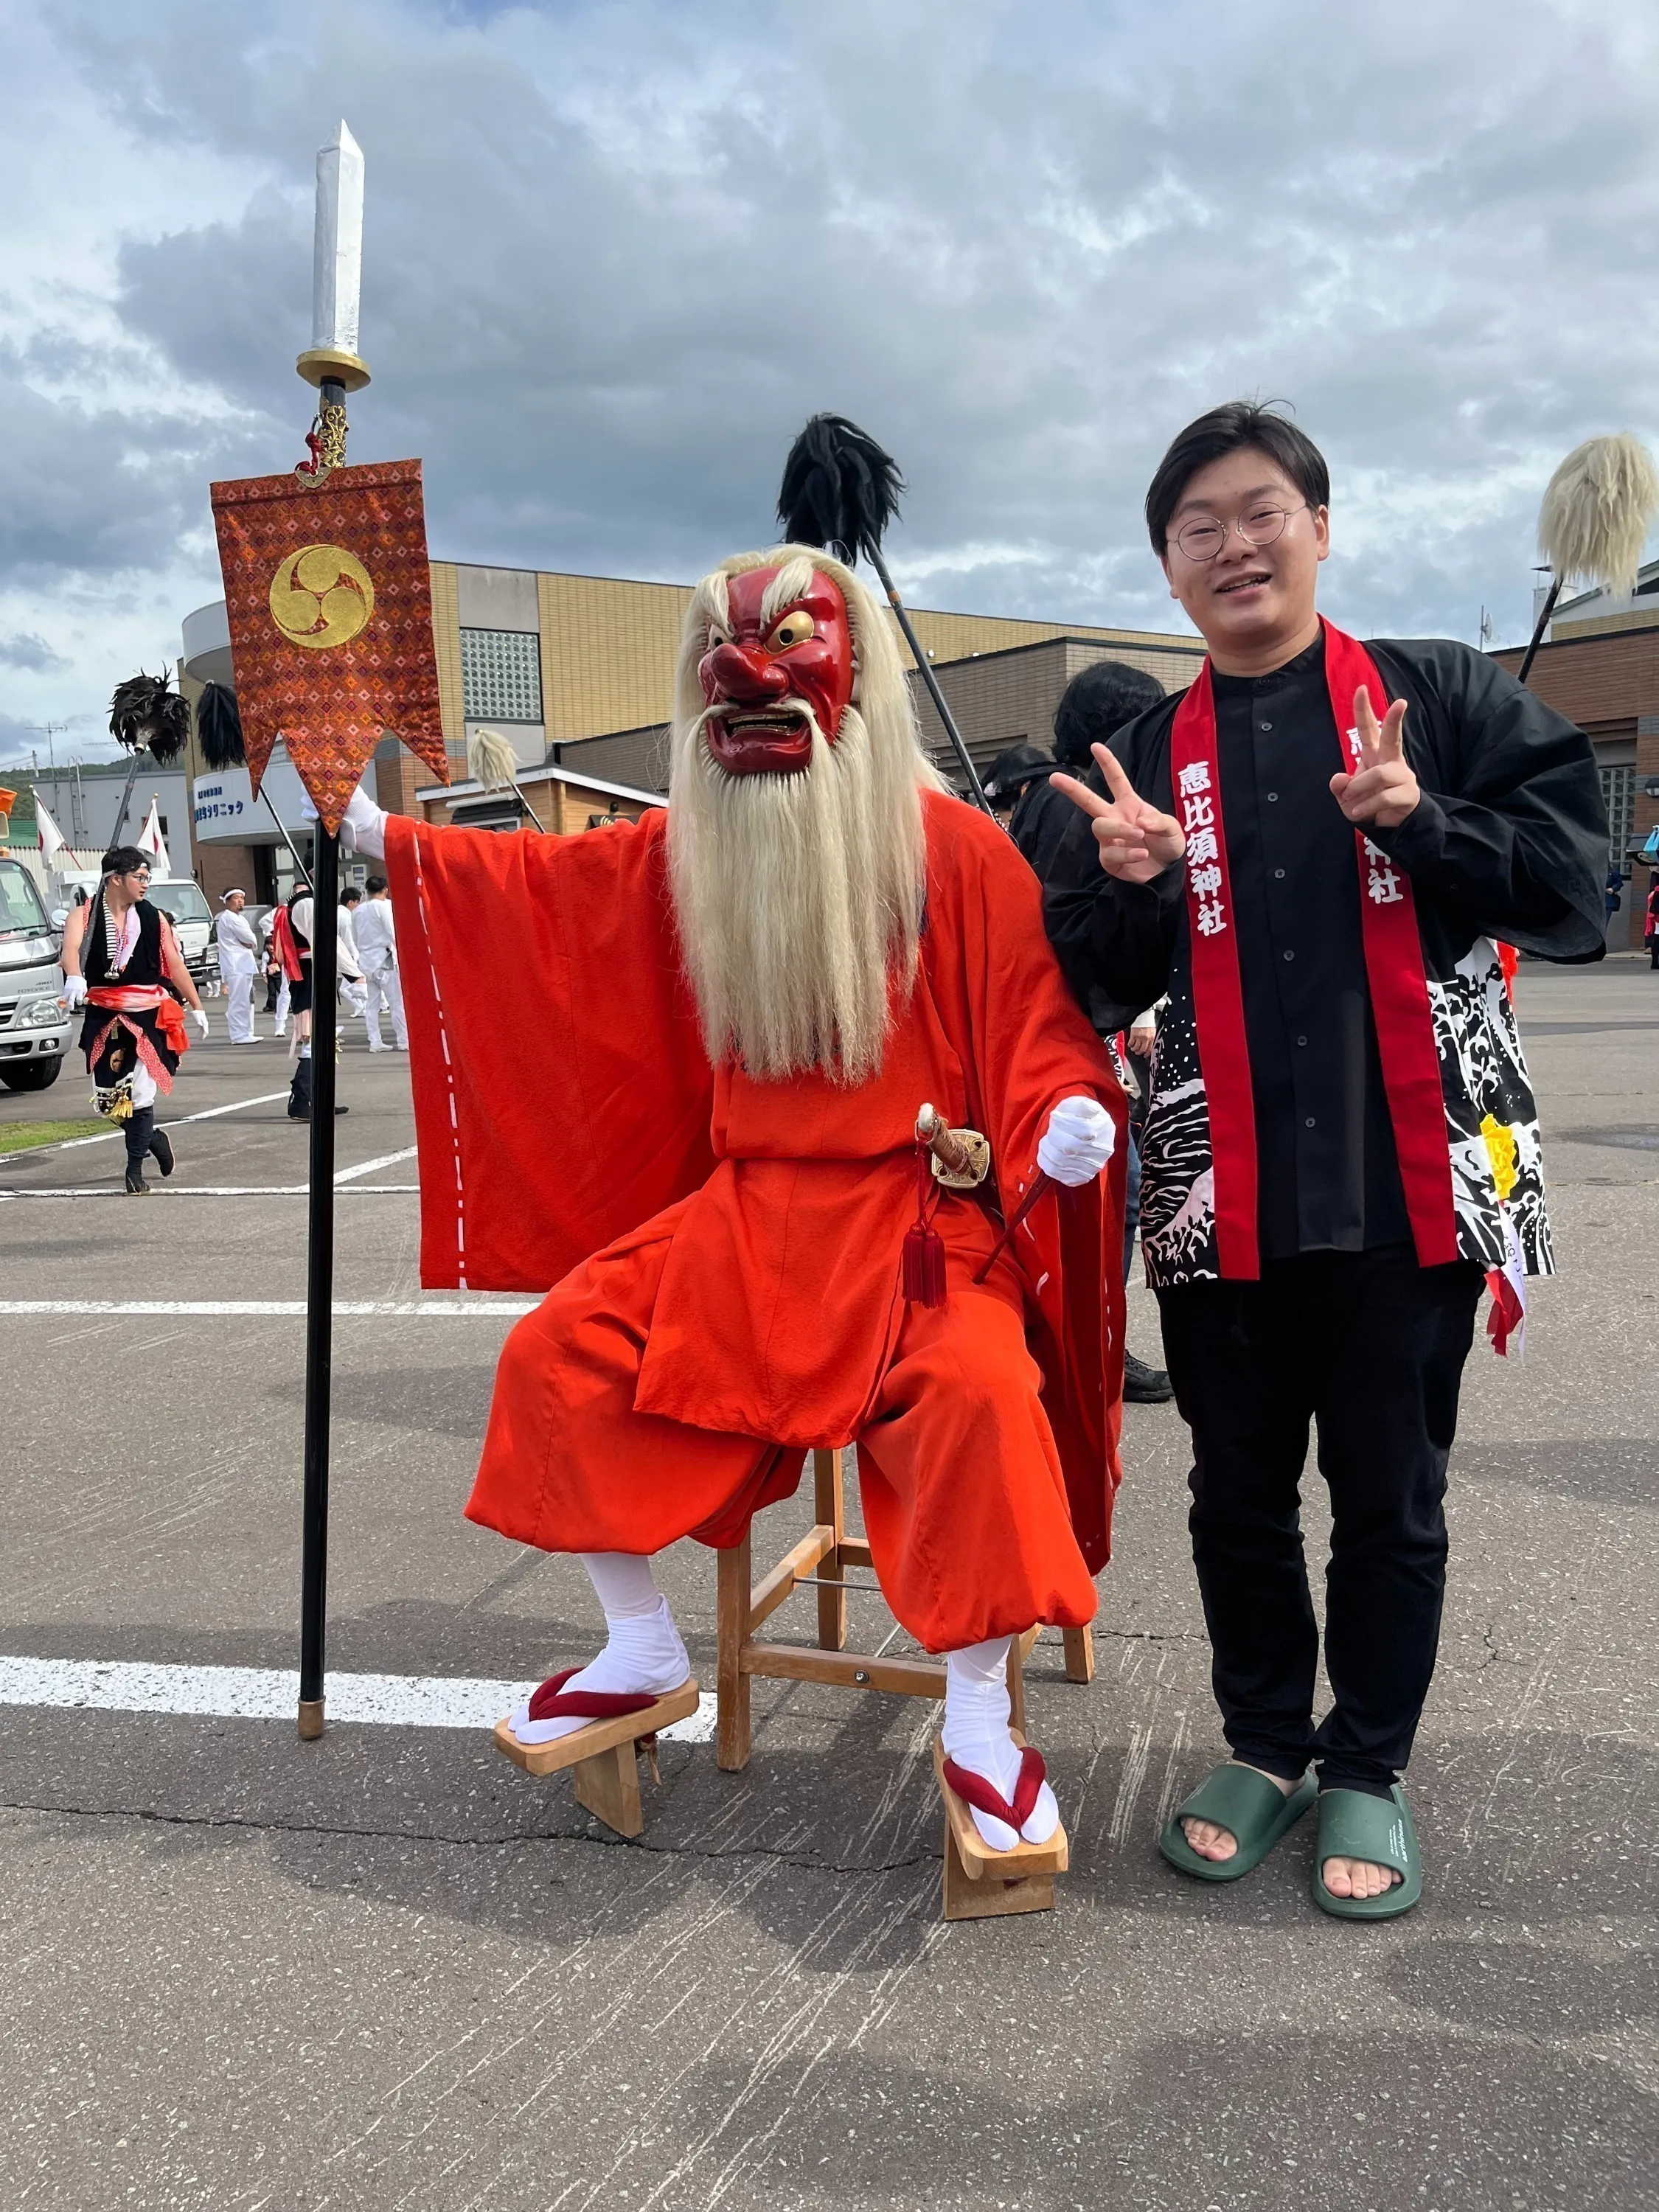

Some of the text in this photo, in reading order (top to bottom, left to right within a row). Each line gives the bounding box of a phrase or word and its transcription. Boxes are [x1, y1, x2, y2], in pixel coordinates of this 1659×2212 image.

[1178, 760, 1228, 936] 恵比須神社
